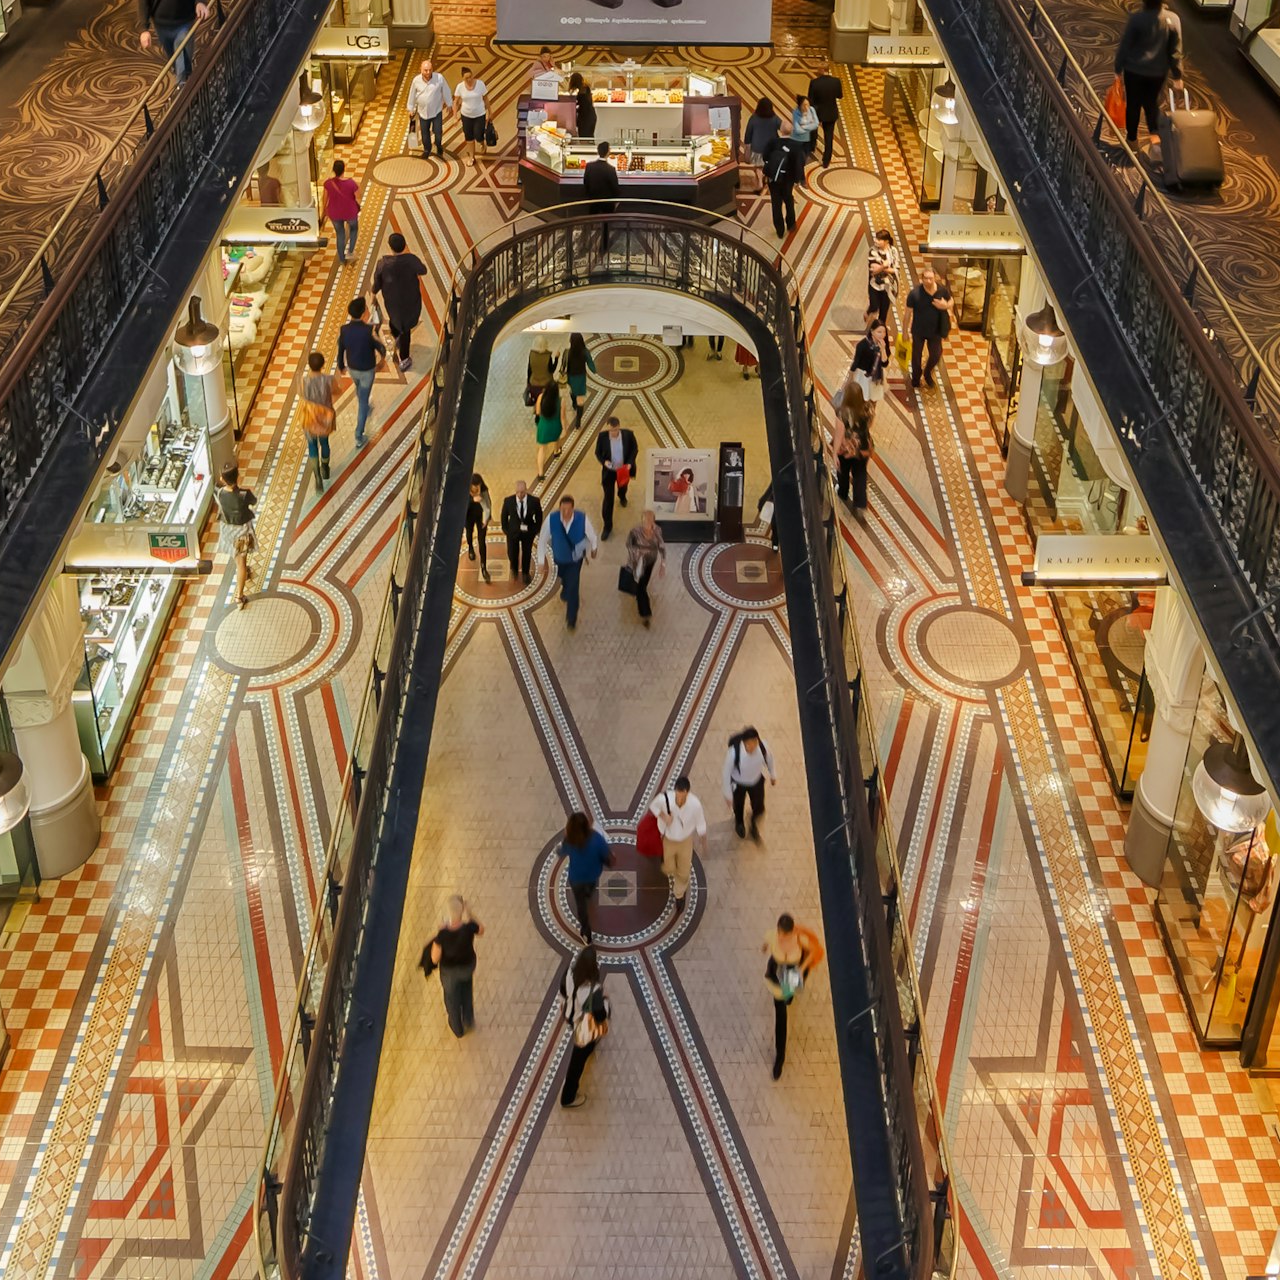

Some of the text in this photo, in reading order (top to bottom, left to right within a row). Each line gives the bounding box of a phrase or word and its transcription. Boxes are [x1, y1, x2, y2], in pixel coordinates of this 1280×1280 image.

[346, 34, 381, 55] UGG
[898, 46, 931, 56] BALE
[155, 535, 182, 548] TAG
